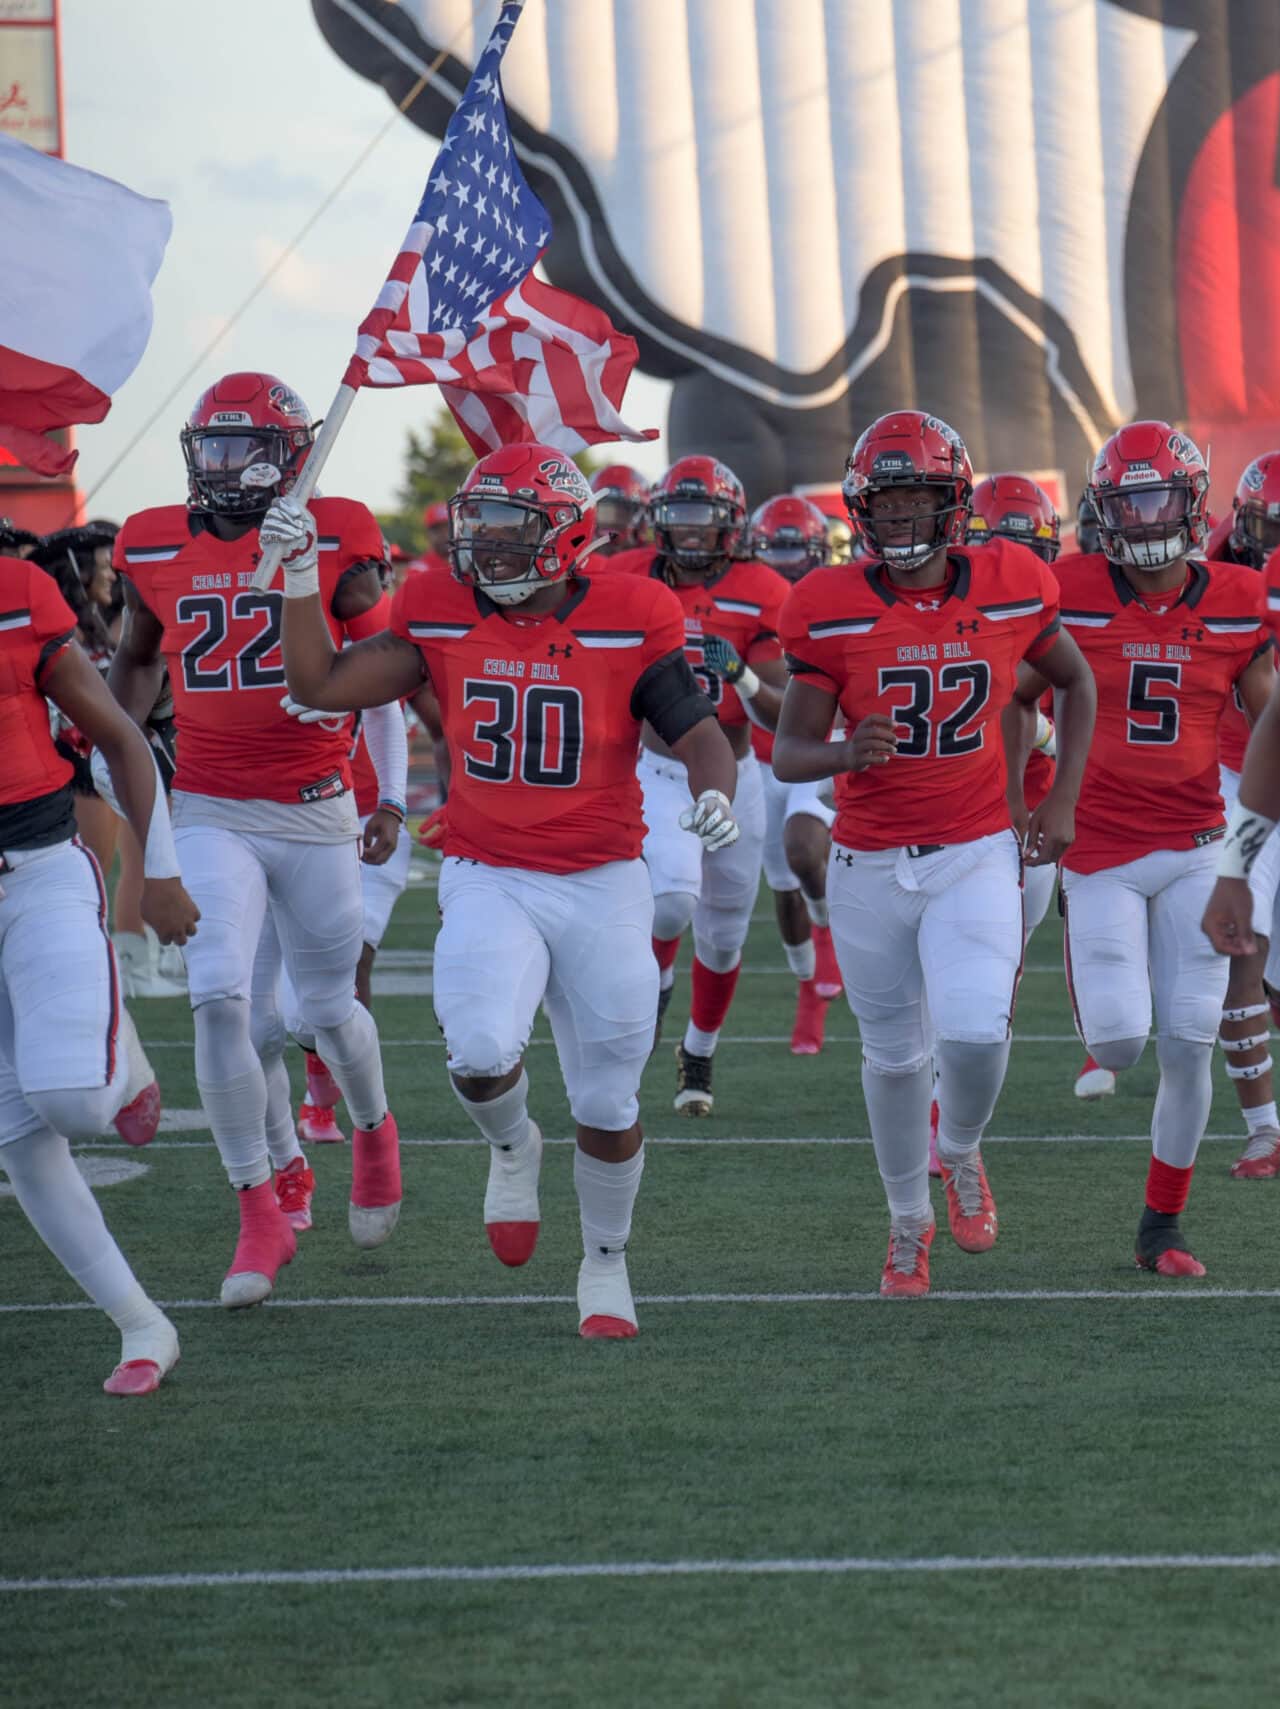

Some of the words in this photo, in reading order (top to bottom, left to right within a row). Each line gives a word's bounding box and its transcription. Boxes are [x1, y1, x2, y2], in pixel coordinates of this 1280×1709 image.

[1124, 472, 1156, 481] Riddell
[192, 573, 231, 590] CEDAR
[176, 590, 288, 692] 22
[896, 644, 938, 662] CEDAR
[943, 641, 971, 658] HILL
[1122, 643, 1161, 659] CEDAR
[1166, 645, 1192, 661] HILL
[483, 658, 525, 678] CEDAR
[531, 662, 560, 681] HILL
[877, 659, 992, 758] 32
[1126, 660, 1182, 746] 5
[463, 677, 584, 788] 30
